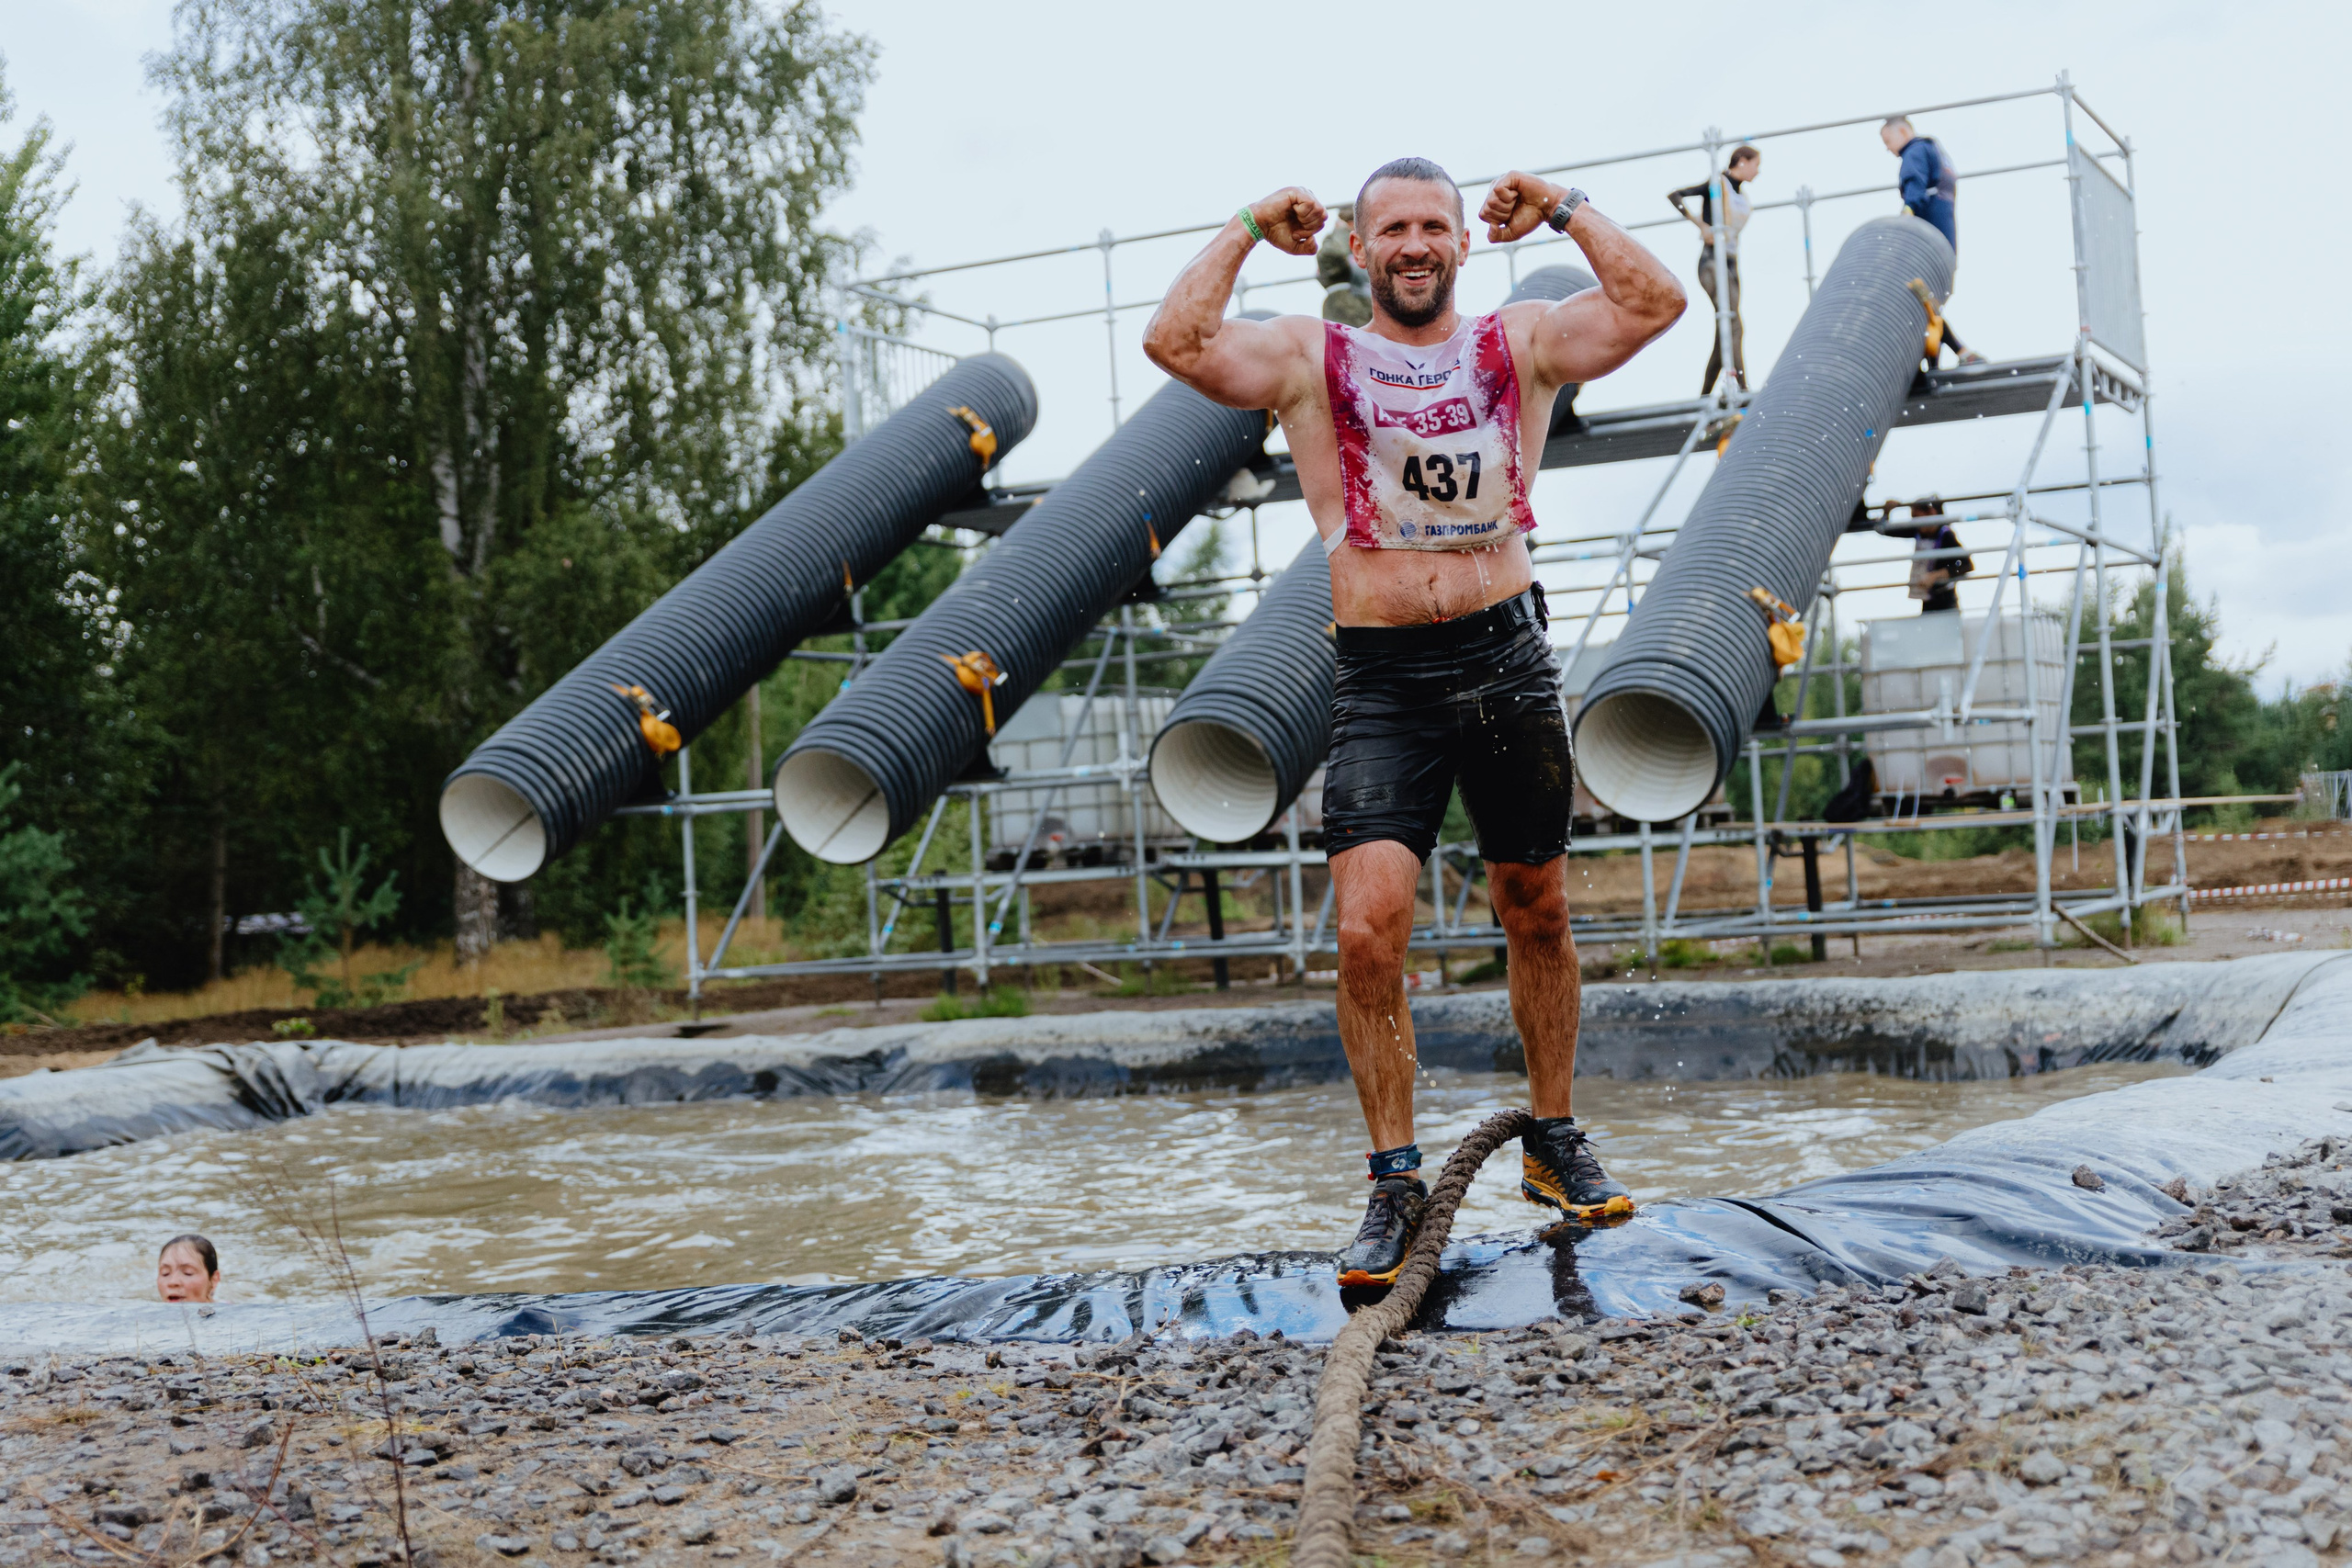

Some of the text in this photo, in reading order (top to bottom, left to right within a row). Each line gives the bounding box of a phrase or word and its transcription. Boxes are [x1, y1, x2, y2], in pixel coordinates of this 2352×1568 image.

[1369, 367, 1415, 386] ГОНКА
[1413, 403, 1471, 434] 35-39
[1402, 451, 1481, 502] 437
[1424, 520, 1498, 536] ГАЗПРОМБАНК
